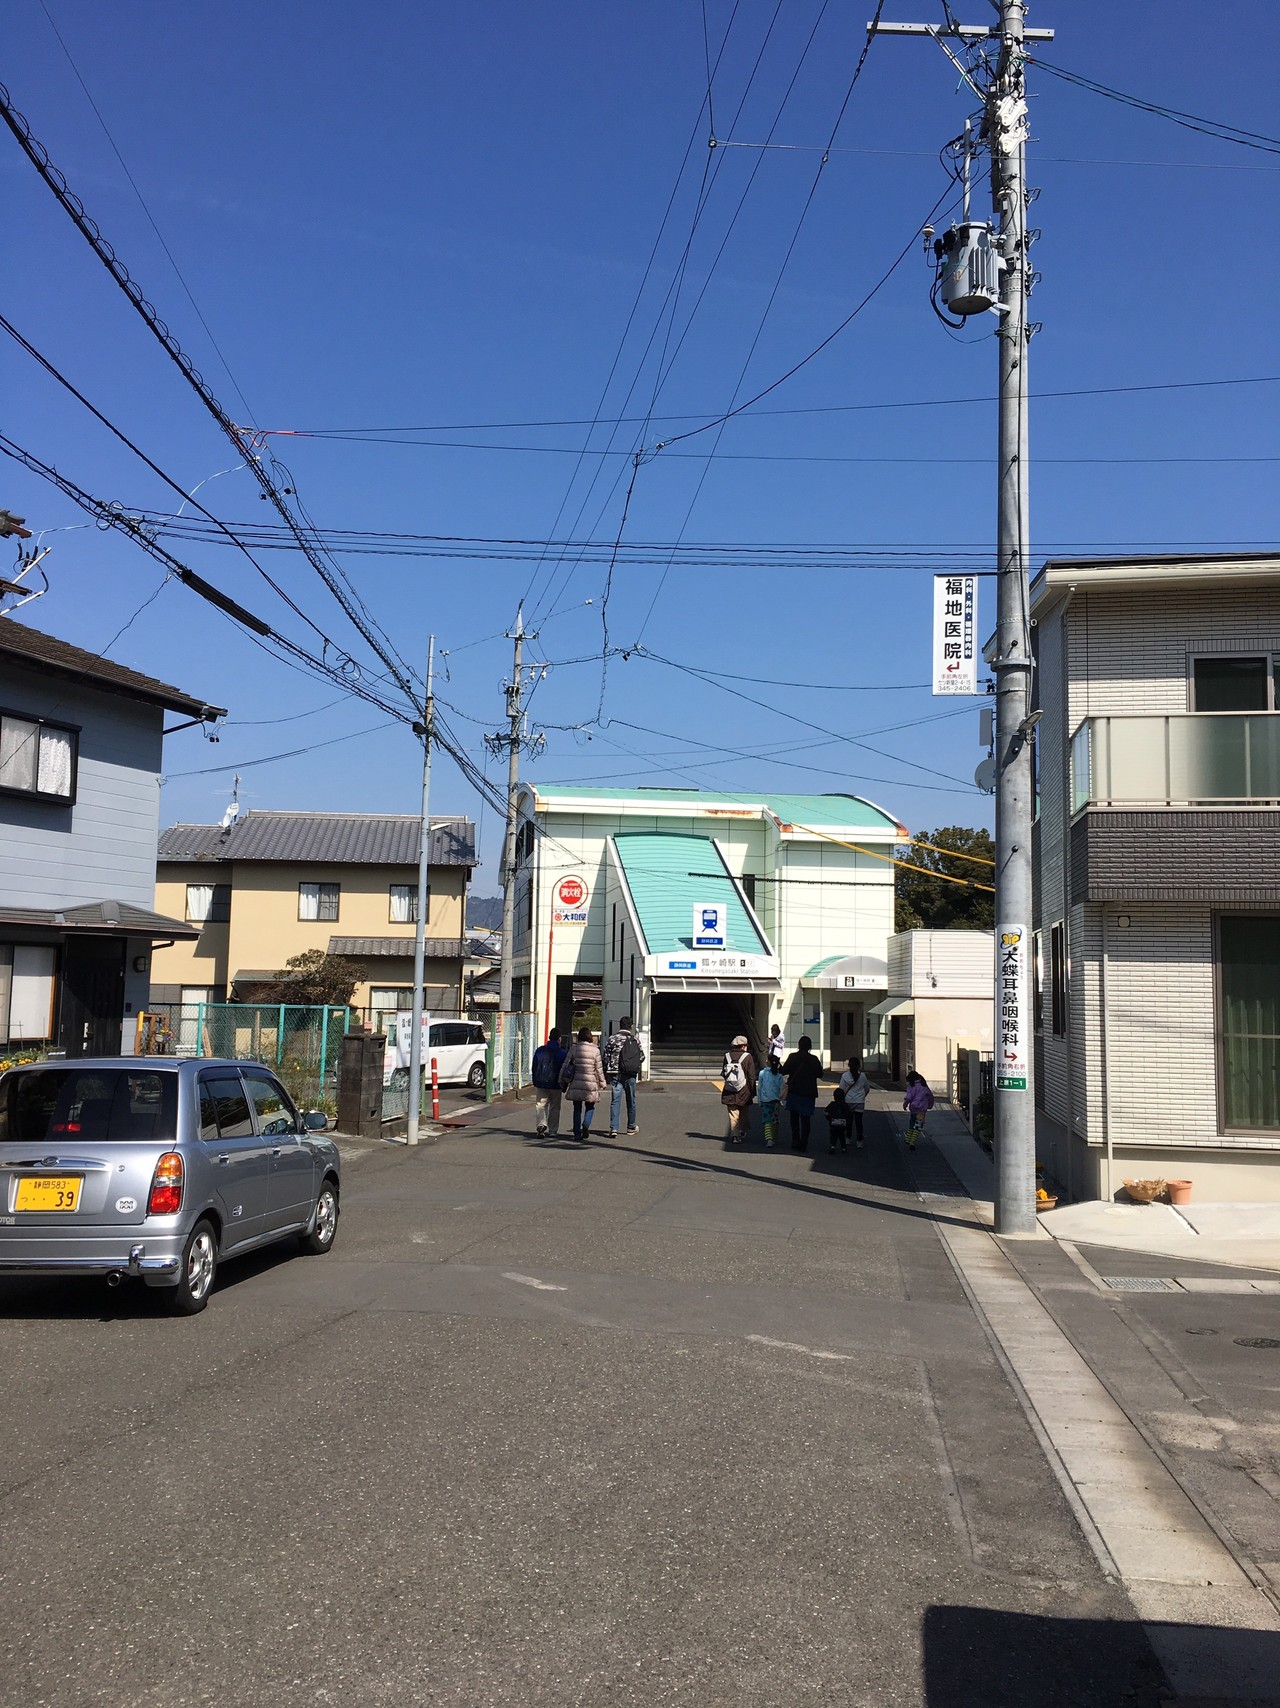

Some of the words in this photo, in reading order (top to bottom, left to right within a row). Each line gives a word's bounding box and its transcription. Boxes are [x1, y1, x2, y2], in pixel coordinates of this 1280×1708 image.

[944, 578, 963, 660] 福地医院
[560, 887, 582, 898] 消火栓
[563, 913, 587, 921] 大和屋
[1002, 950, 1019, 1046] 大蝶耳鼻咽喉科
